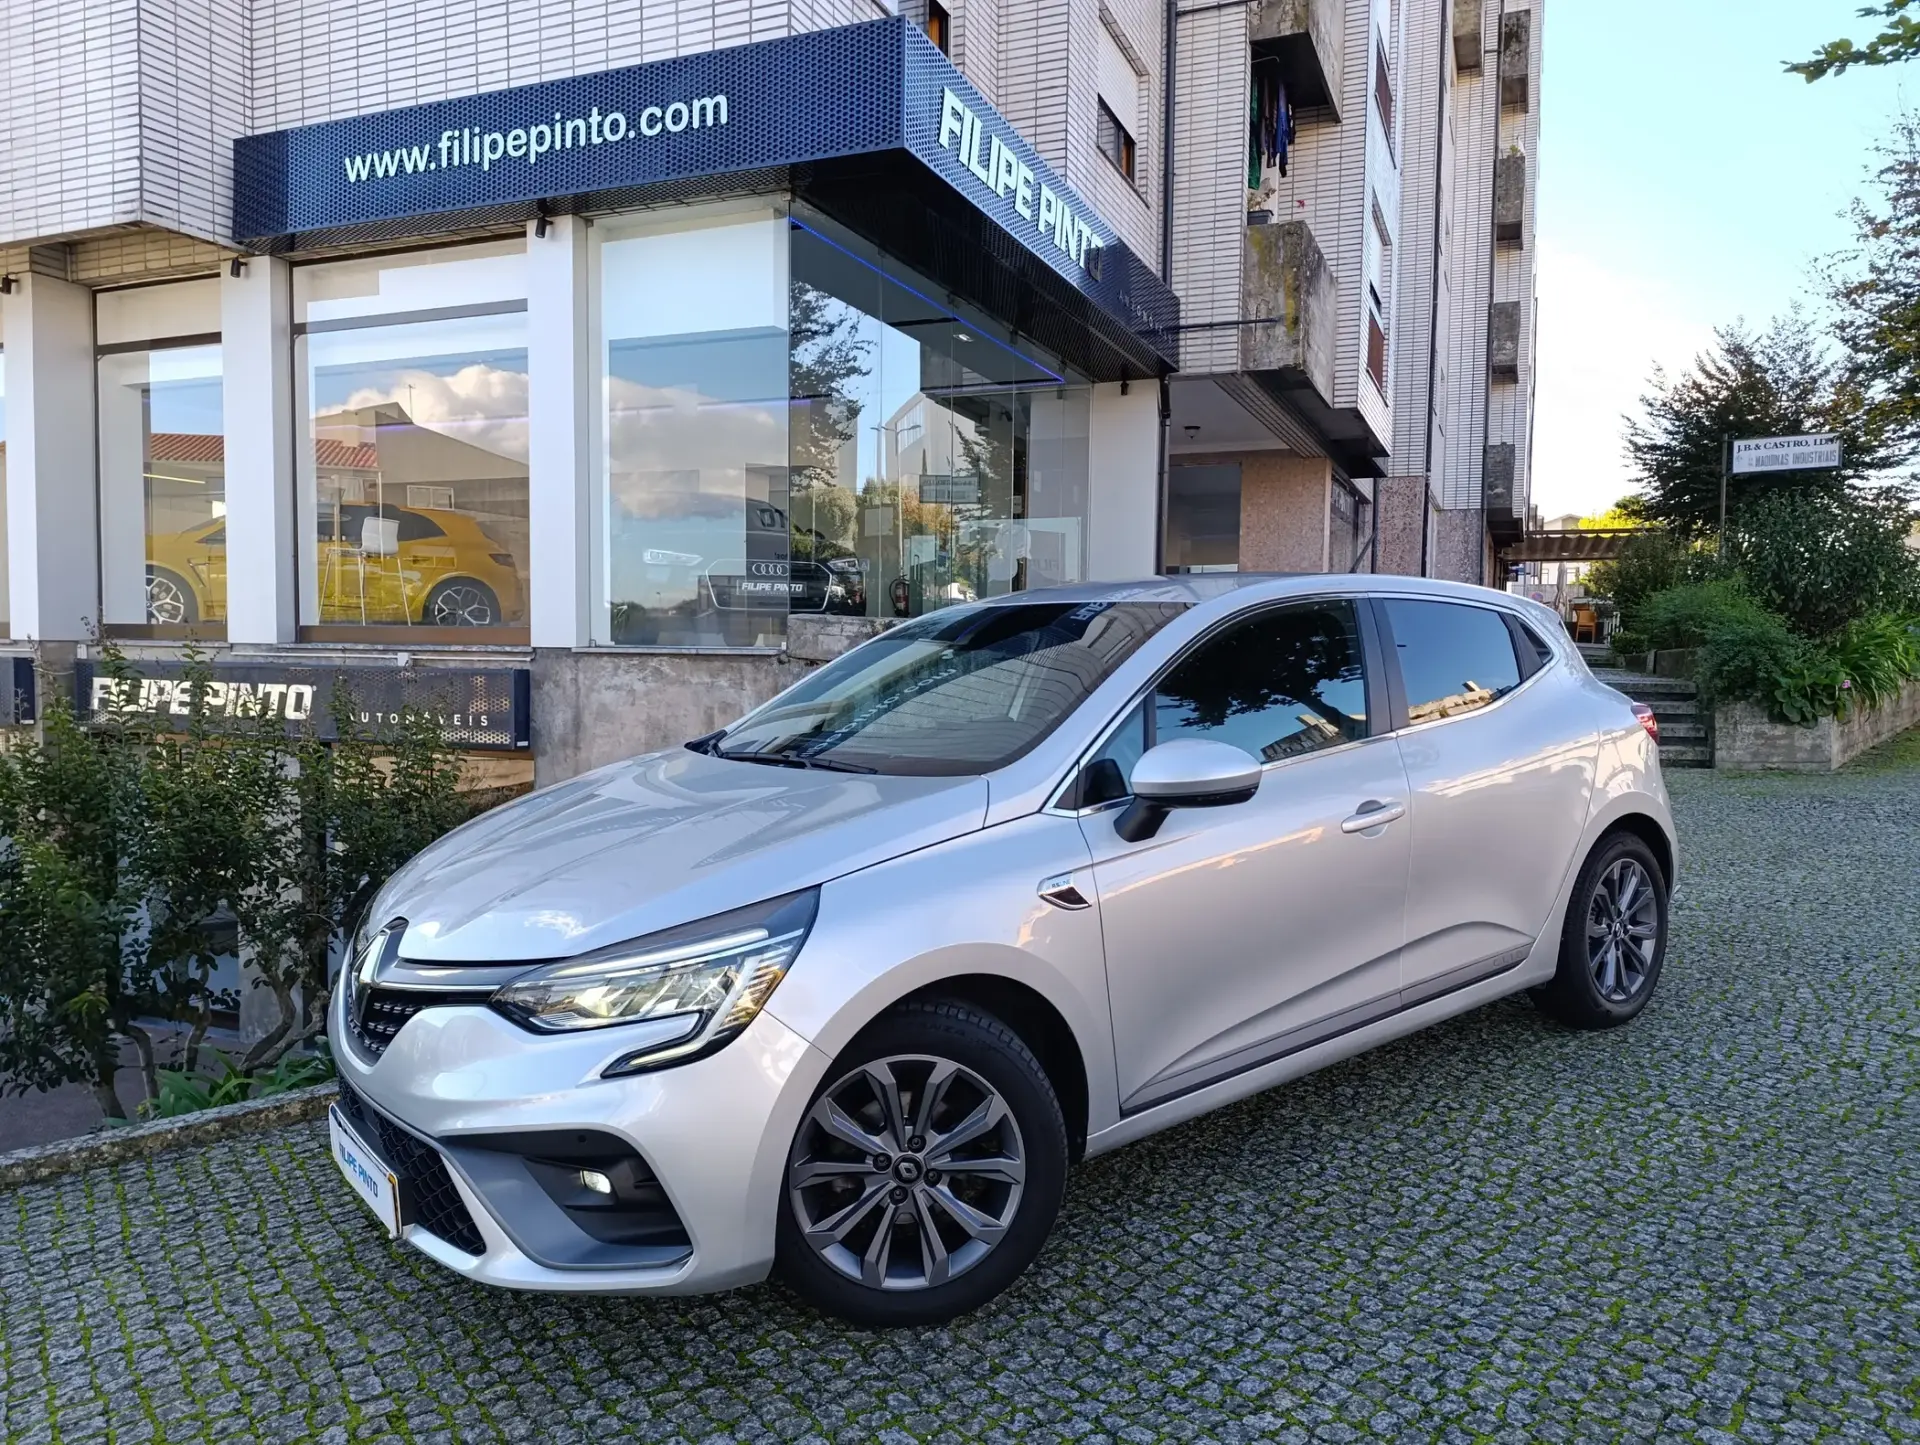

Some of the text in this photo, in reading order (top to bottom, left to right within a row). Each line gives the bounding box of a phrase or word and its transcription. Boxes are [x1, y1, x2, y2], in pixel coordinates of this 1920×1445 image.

[344, 93, 729, 183] www.filipepinto.com
[938, 86, 1104, 282] FILIPE PINTO
[1754, 443, 1762, 451] &
[742, 582, 803, 592] FILIPE PINTO
